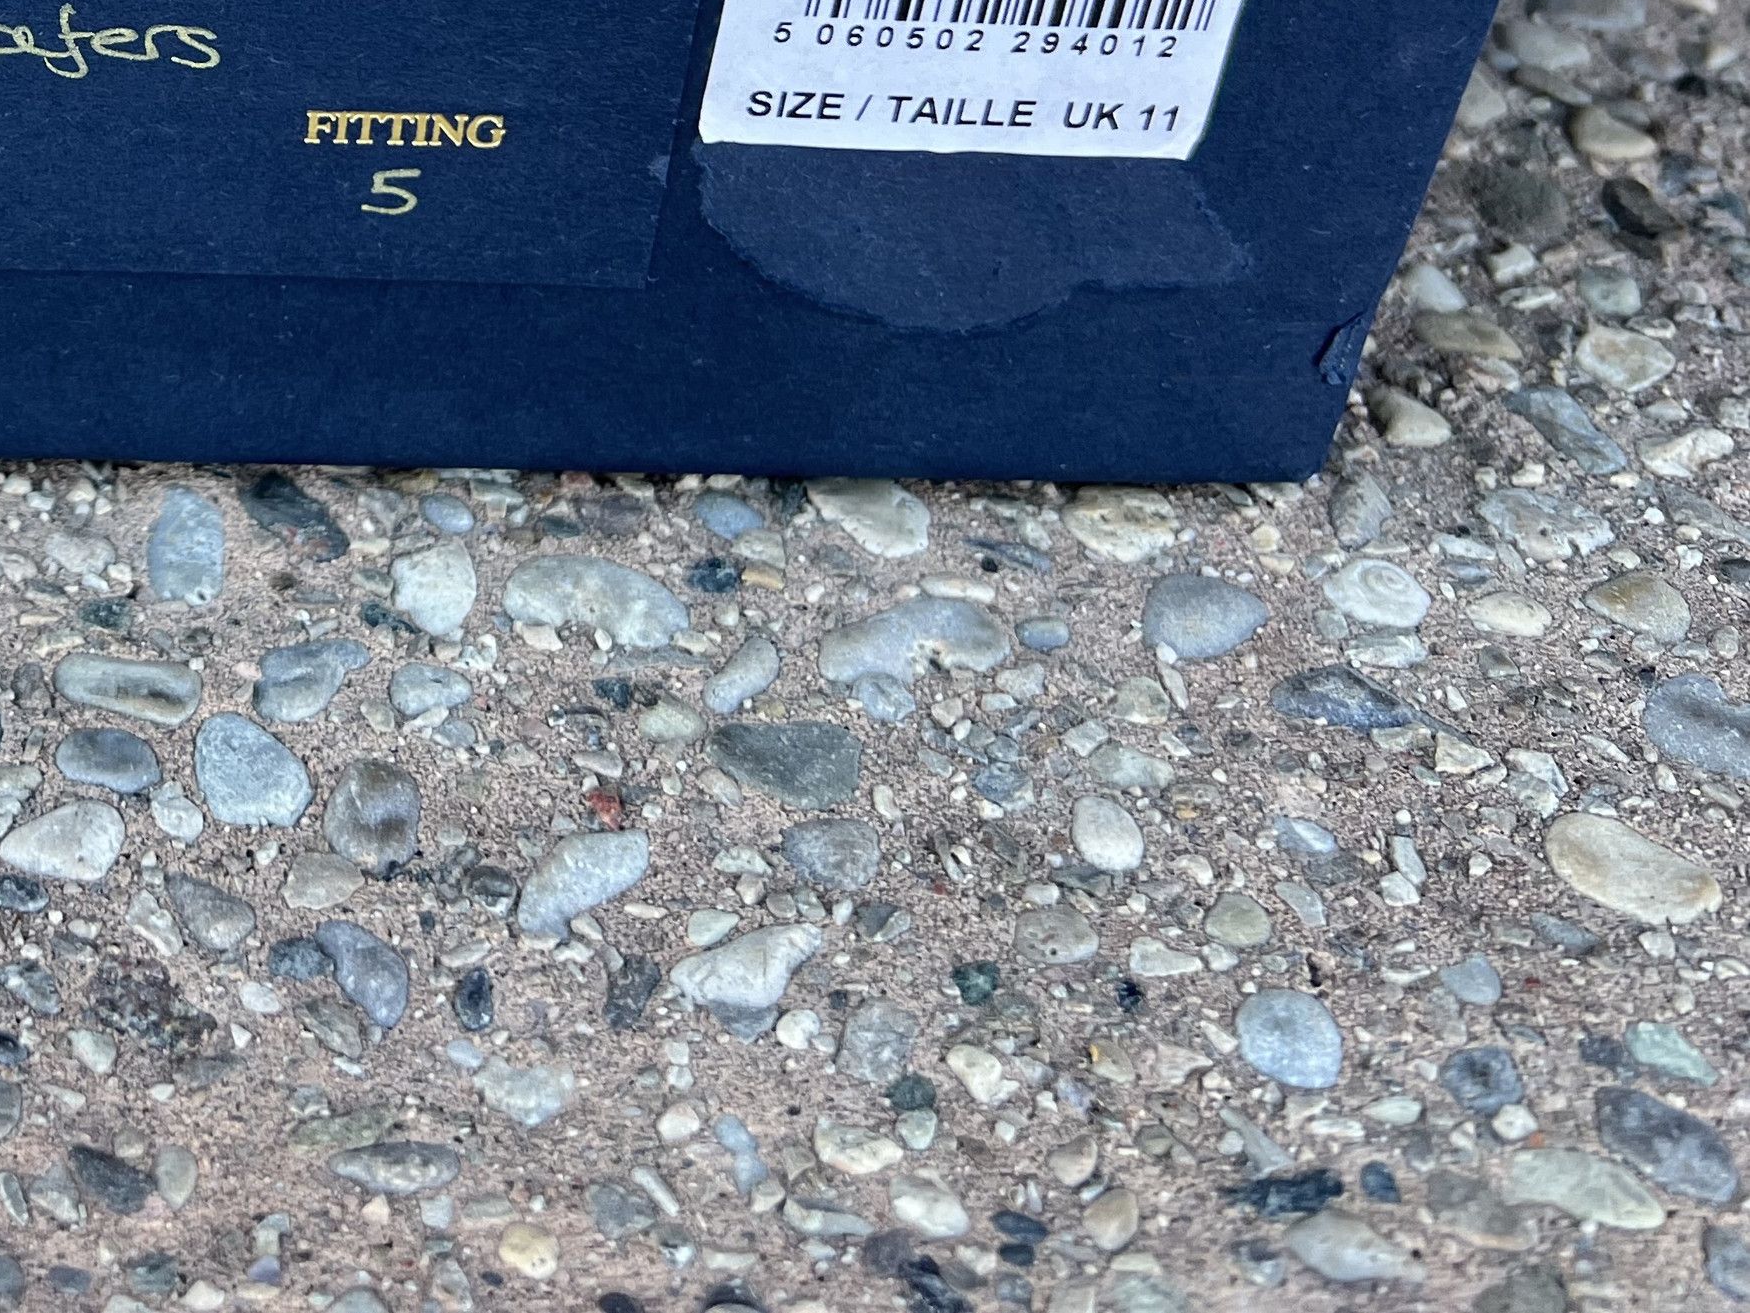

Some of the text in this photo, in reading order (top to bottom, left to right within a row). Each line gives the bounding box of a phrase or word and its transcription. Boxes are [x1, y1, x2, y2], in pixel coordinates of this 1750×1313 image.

[303, 111, 506, 148] FITTING
[747, 90, 845, 120] SIZE
[888, 95, 1037, 127] TAILLE
[1063, 102, 1123, 130] UK
[1140, 104, 1179, 132] 11
[361, 168, 421, 215] 5
